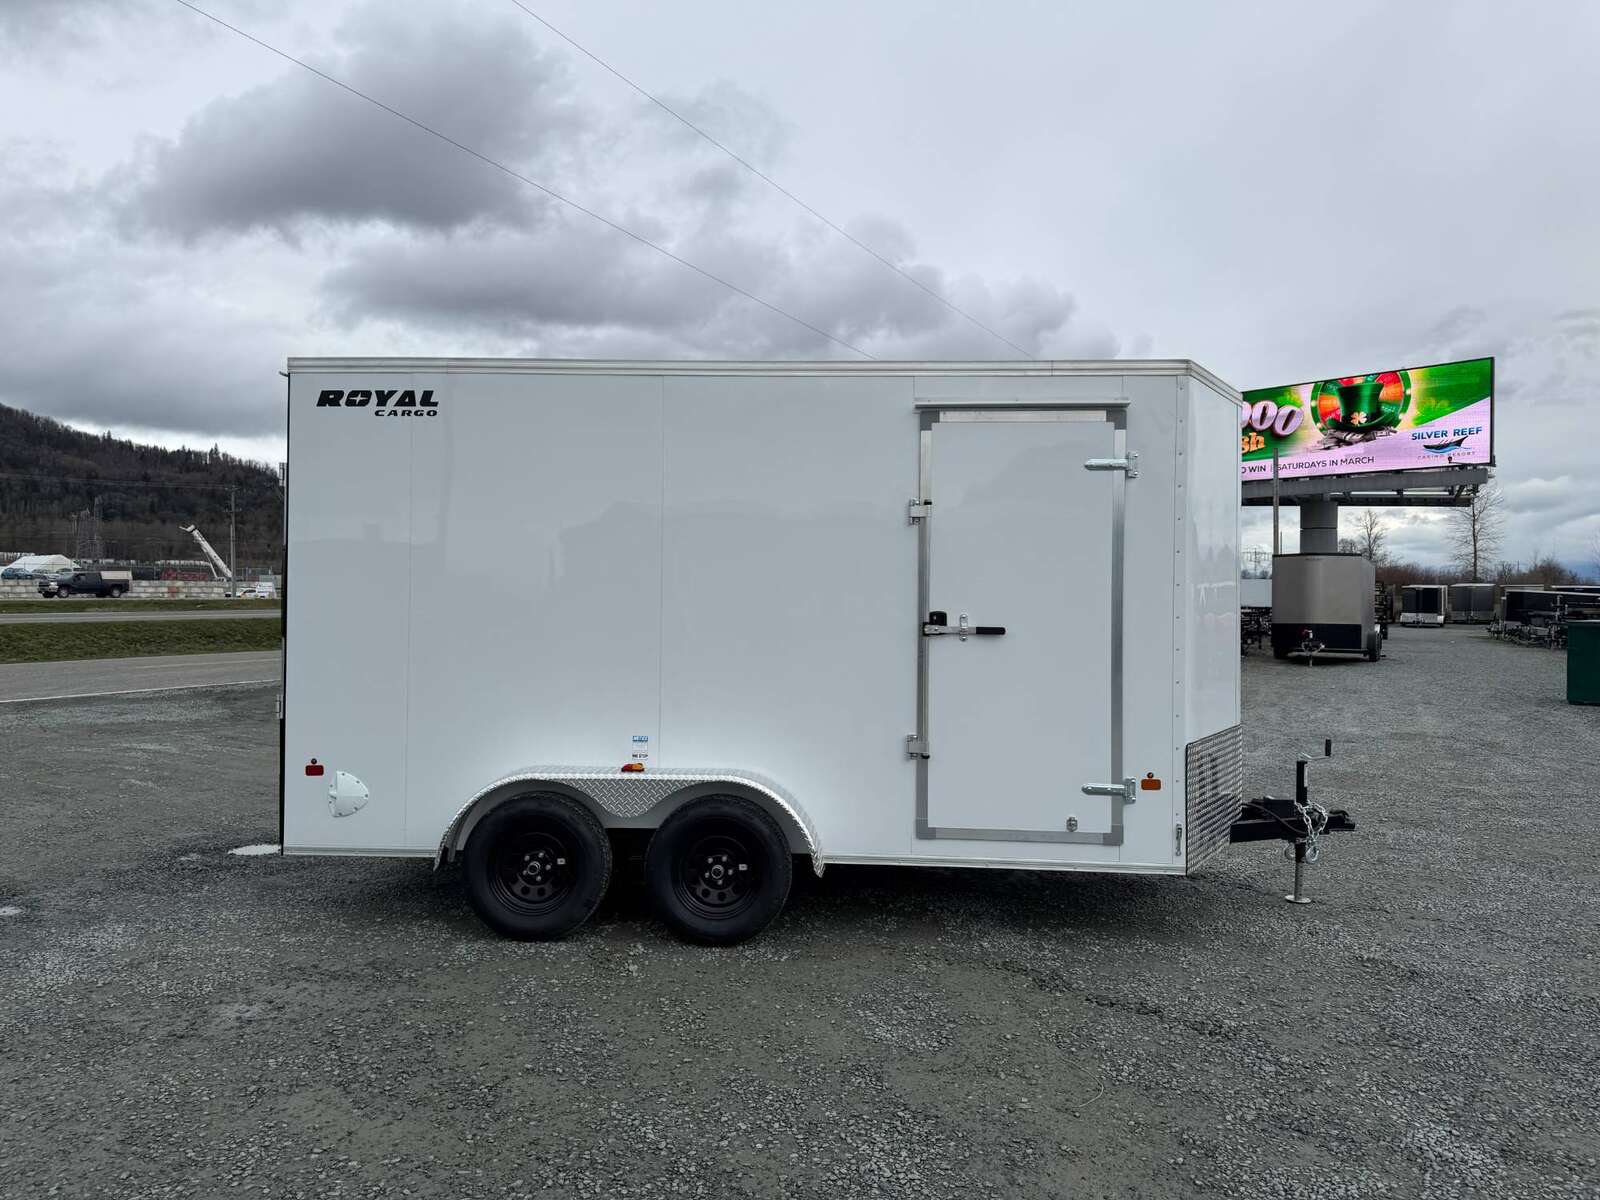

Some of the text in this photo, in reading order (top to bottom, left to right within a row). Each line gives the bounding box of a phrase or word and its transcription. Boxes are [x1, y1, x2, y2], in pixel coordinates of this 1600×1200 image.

[316, 390, 439, 407] ROYAL
[1411, 426, 1482, 440] SILVER REEF
[1248, 465, 1266, 473] WIN
[1278, 459, 1327, 470] SATURDAYS
[1329, 459, 1338, 467] IN
[1340, 456, 1375, 465] MARCH
